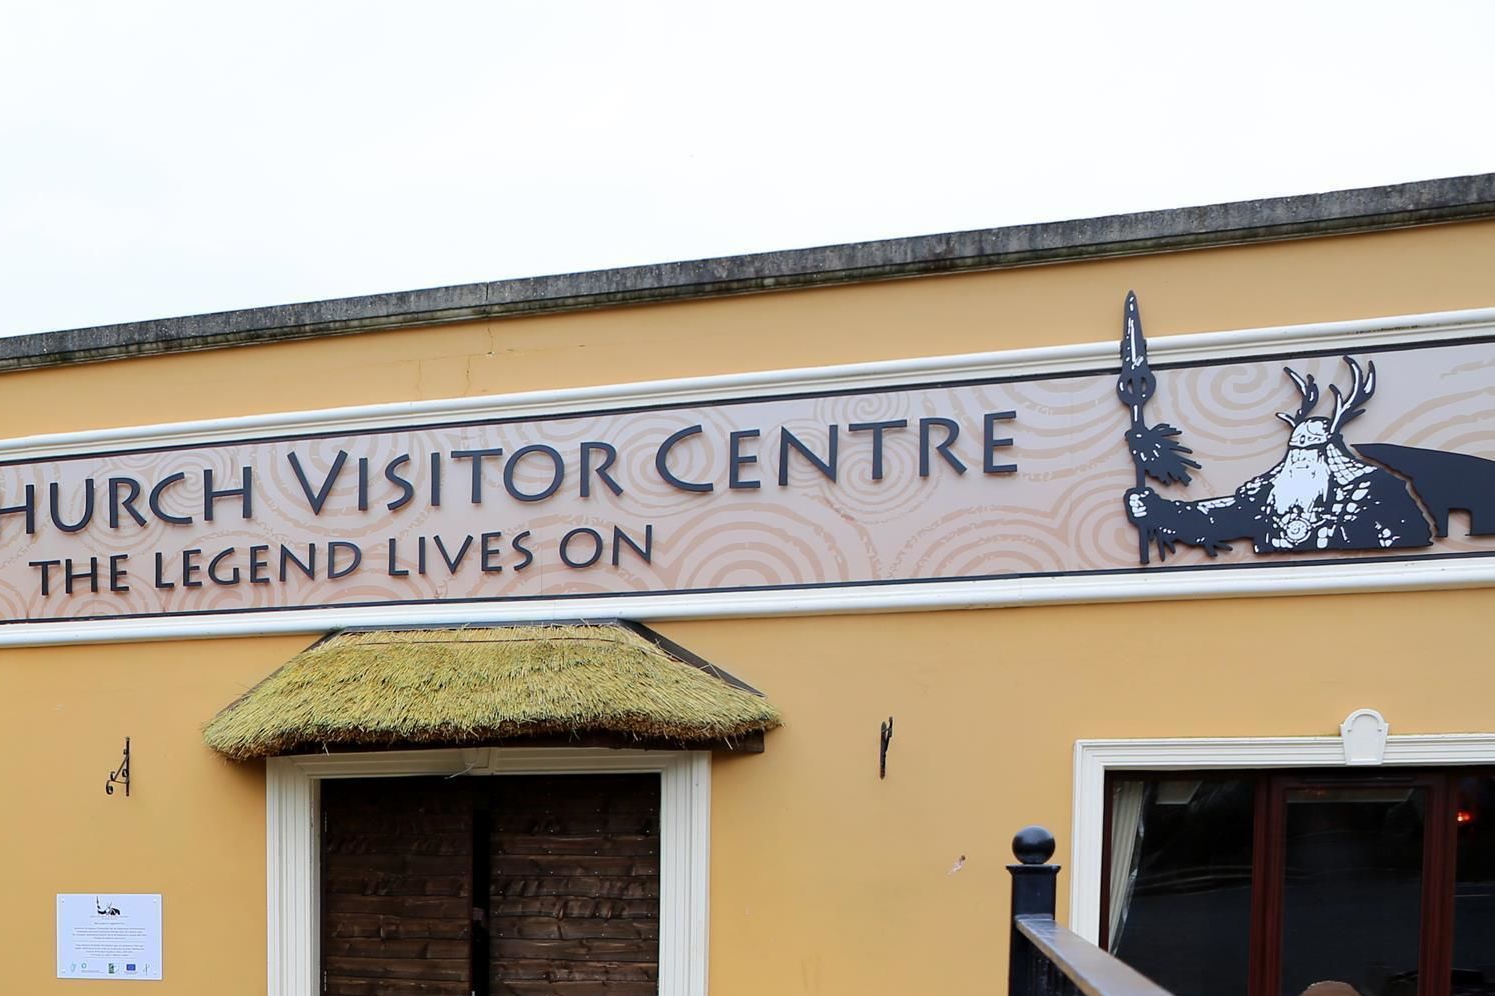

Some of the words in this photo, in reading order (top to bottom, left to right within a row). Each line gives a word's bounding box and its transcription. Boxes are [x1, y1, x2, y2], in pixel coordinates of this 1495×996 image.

[287, 441, 624, 517] VISITOR
[655, 410, 1018, 496] CENTRE
[28, 553, 130, 597] THE
[155, 541, 362, 592] LEGEND
[388, 530, 534, 580] LIVES
[559, 524, 653, 570] ON
